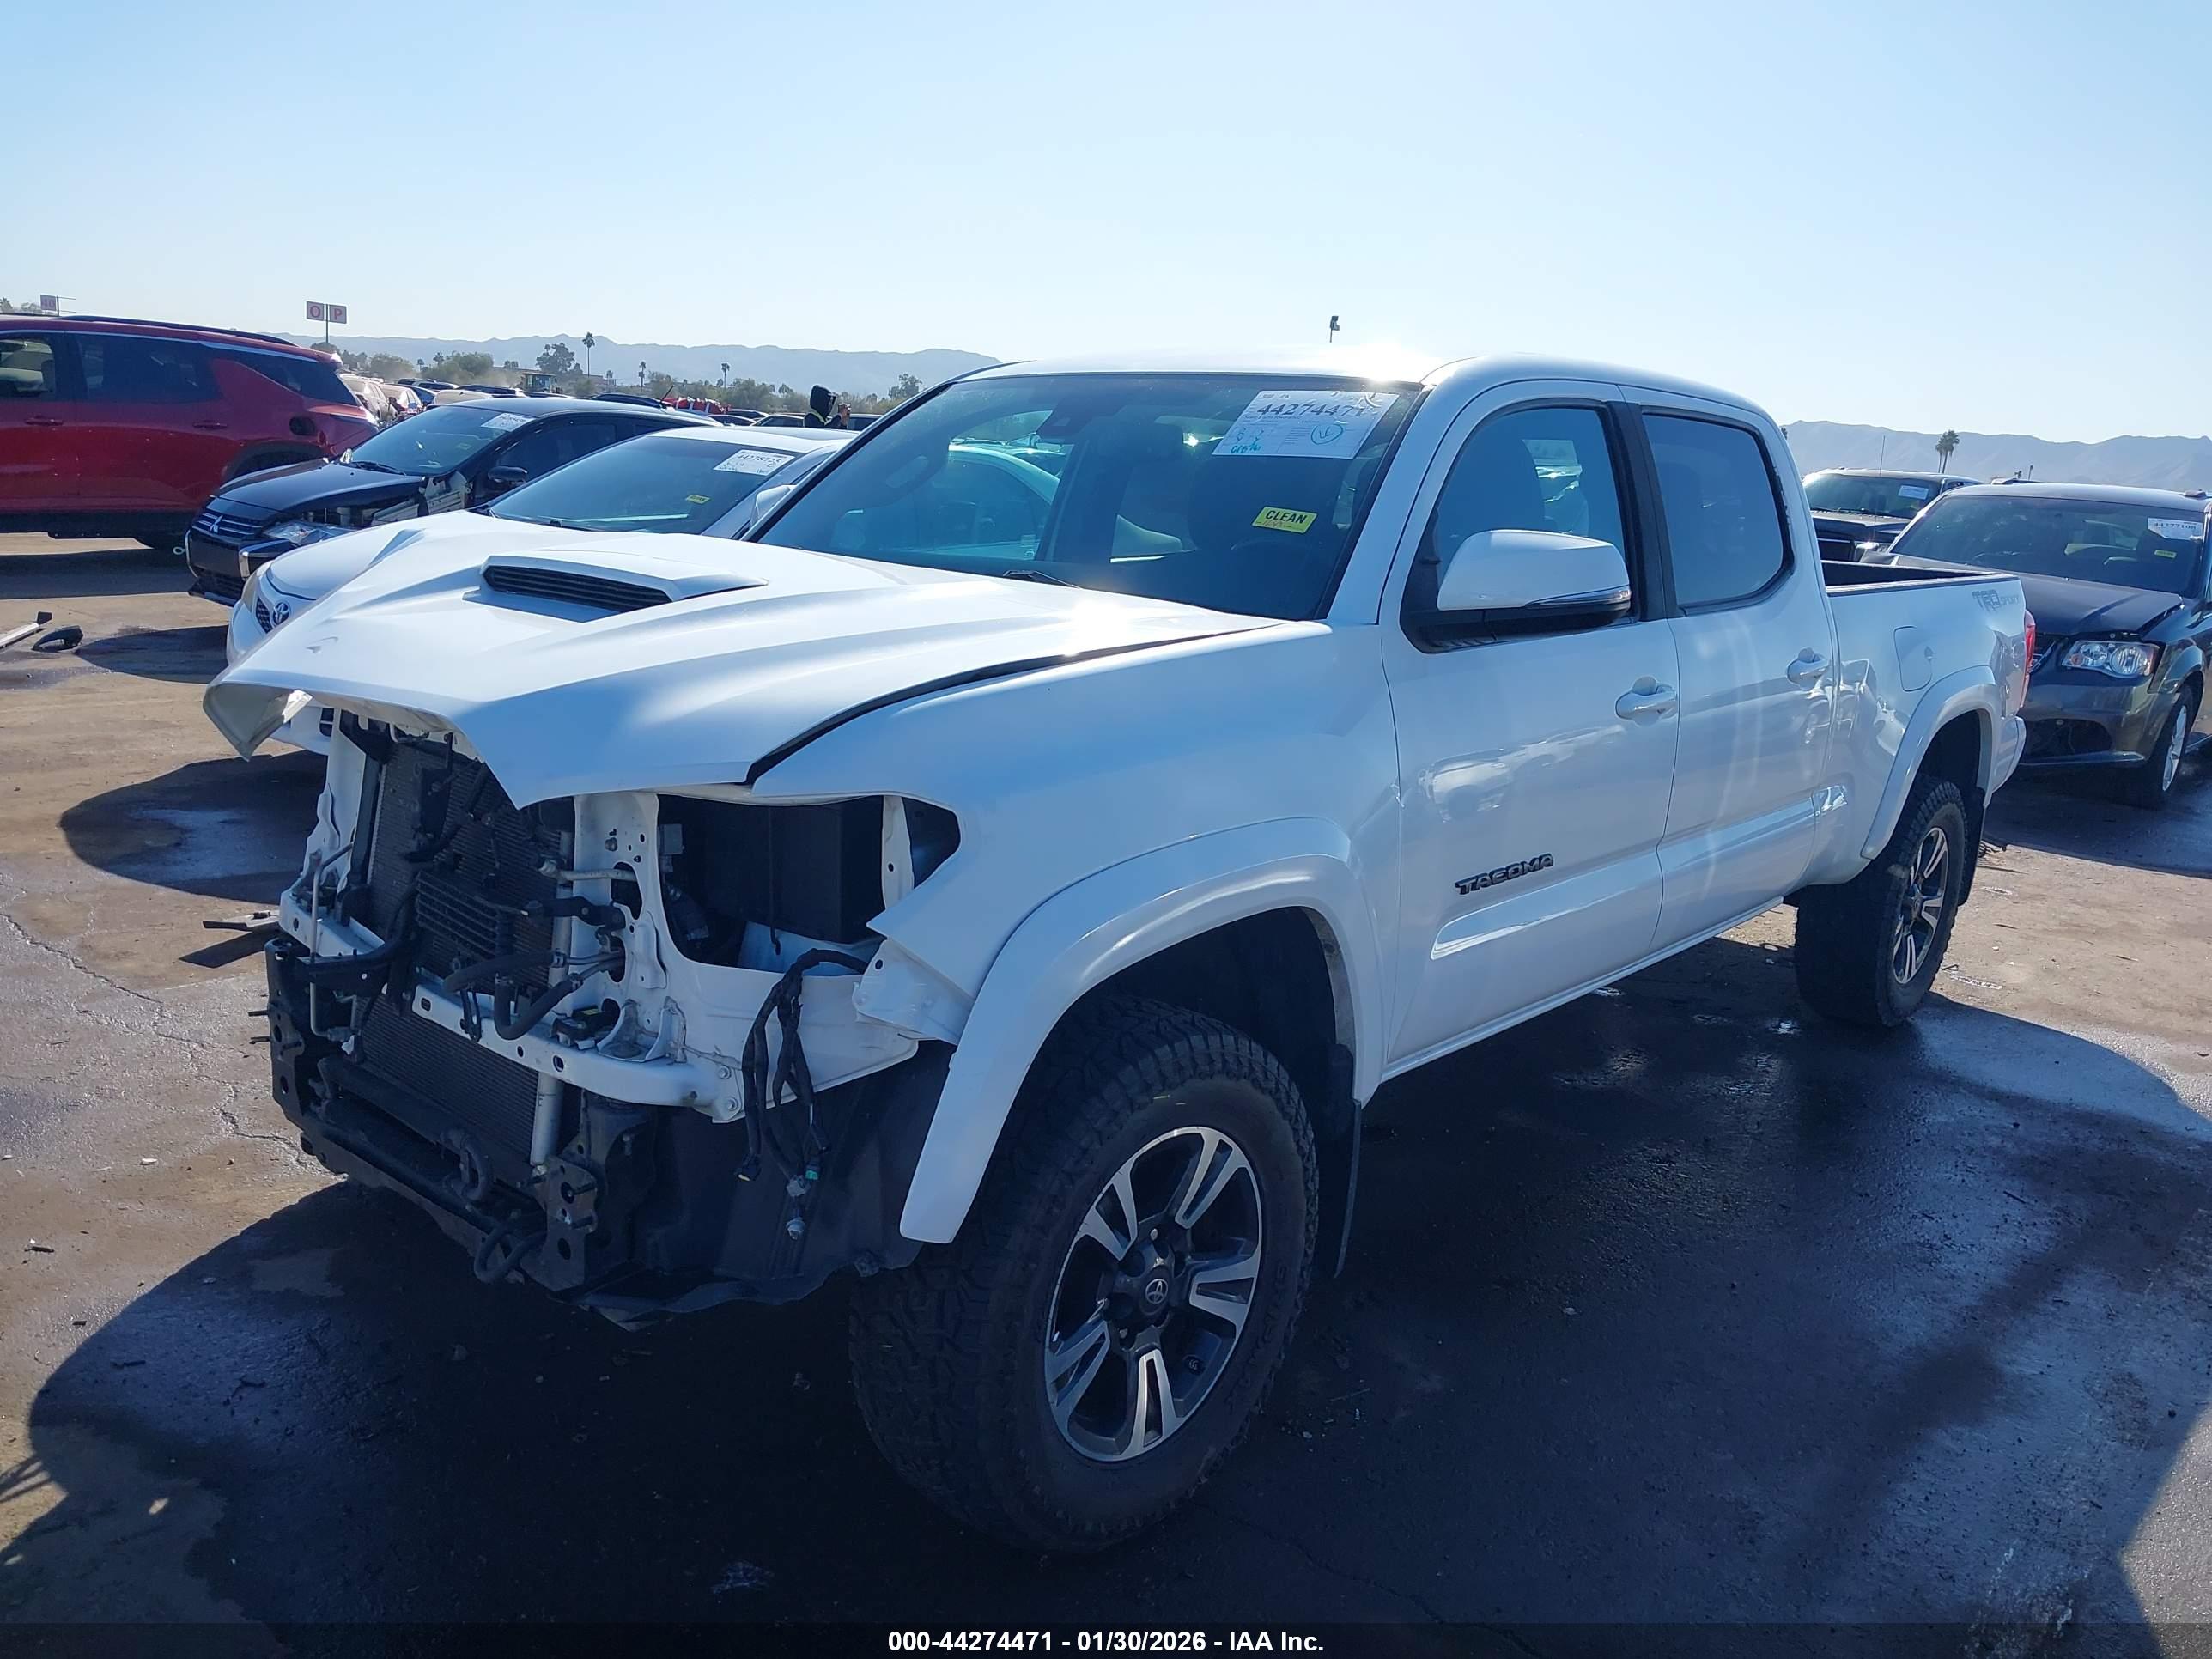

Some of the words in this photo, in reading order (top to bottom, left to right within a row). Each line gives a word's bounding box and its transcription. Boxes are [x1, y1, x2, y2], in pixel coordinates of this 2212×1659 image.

[310, 305, 321, 318] O
[333, 308, 343, 320] P
[1256, 404, 1362, 417] 44274471
[1265, 510, 1307, 523] CLEAN
[1972, 589, 2001, 613] TRD
[1455, 853, 1554, 895] TACOMA
